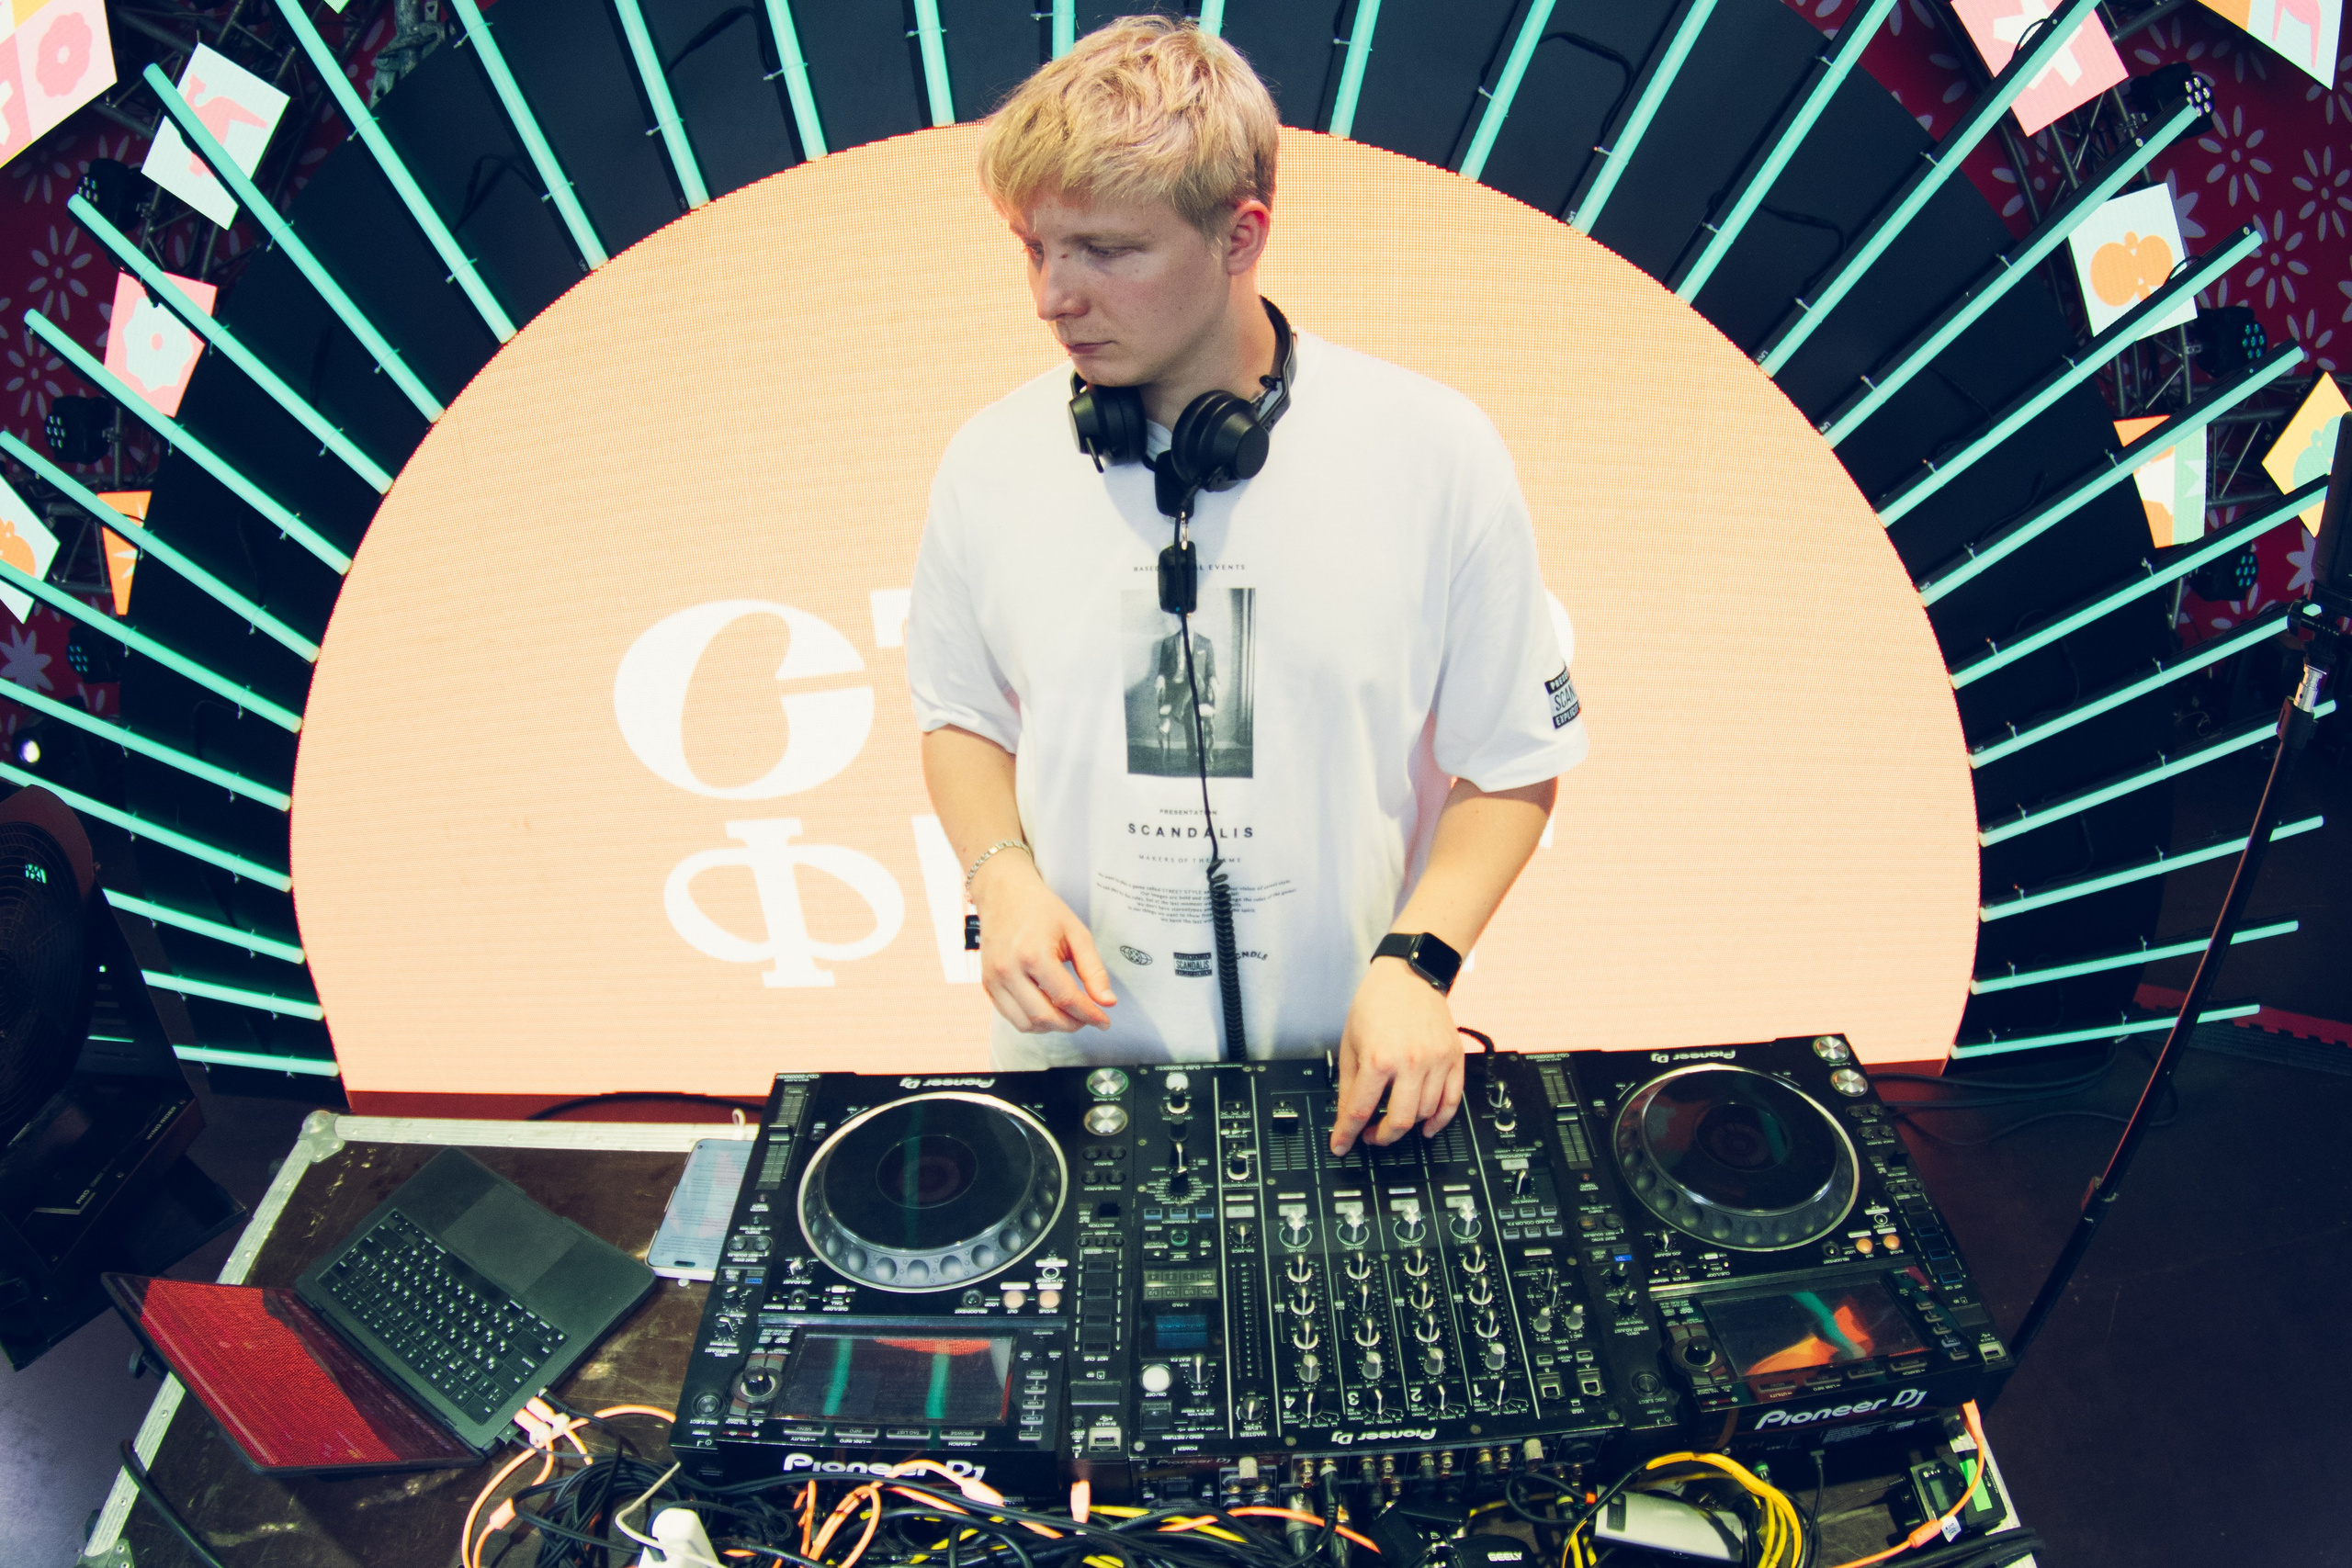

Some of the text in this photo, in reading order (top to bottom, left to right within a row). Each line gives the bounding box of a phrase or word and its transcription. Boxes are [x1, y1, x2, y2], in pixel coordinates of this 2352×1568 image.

[1128, 823, 1253, 839] SCANDALIS
[1138, 854, 1175, 863] MAKERS
[1176, 960, 1210, 970] SCANDALIS
[1673, 1049, 1736, 1061] Pioneer
[1409, 1387, 1422, 1402] 2
[1473, 1382, 1483, 1398] 1
[1283, 1394, 1296, 1409] 4
[1347, 1391, 1360, 1406] 3
[1754, 1397, 1887, 1430] Pioneer
[1358, 1427, 1437, 1440] Pioneer
[1487, 1551, 1522, 1562] GEELY
